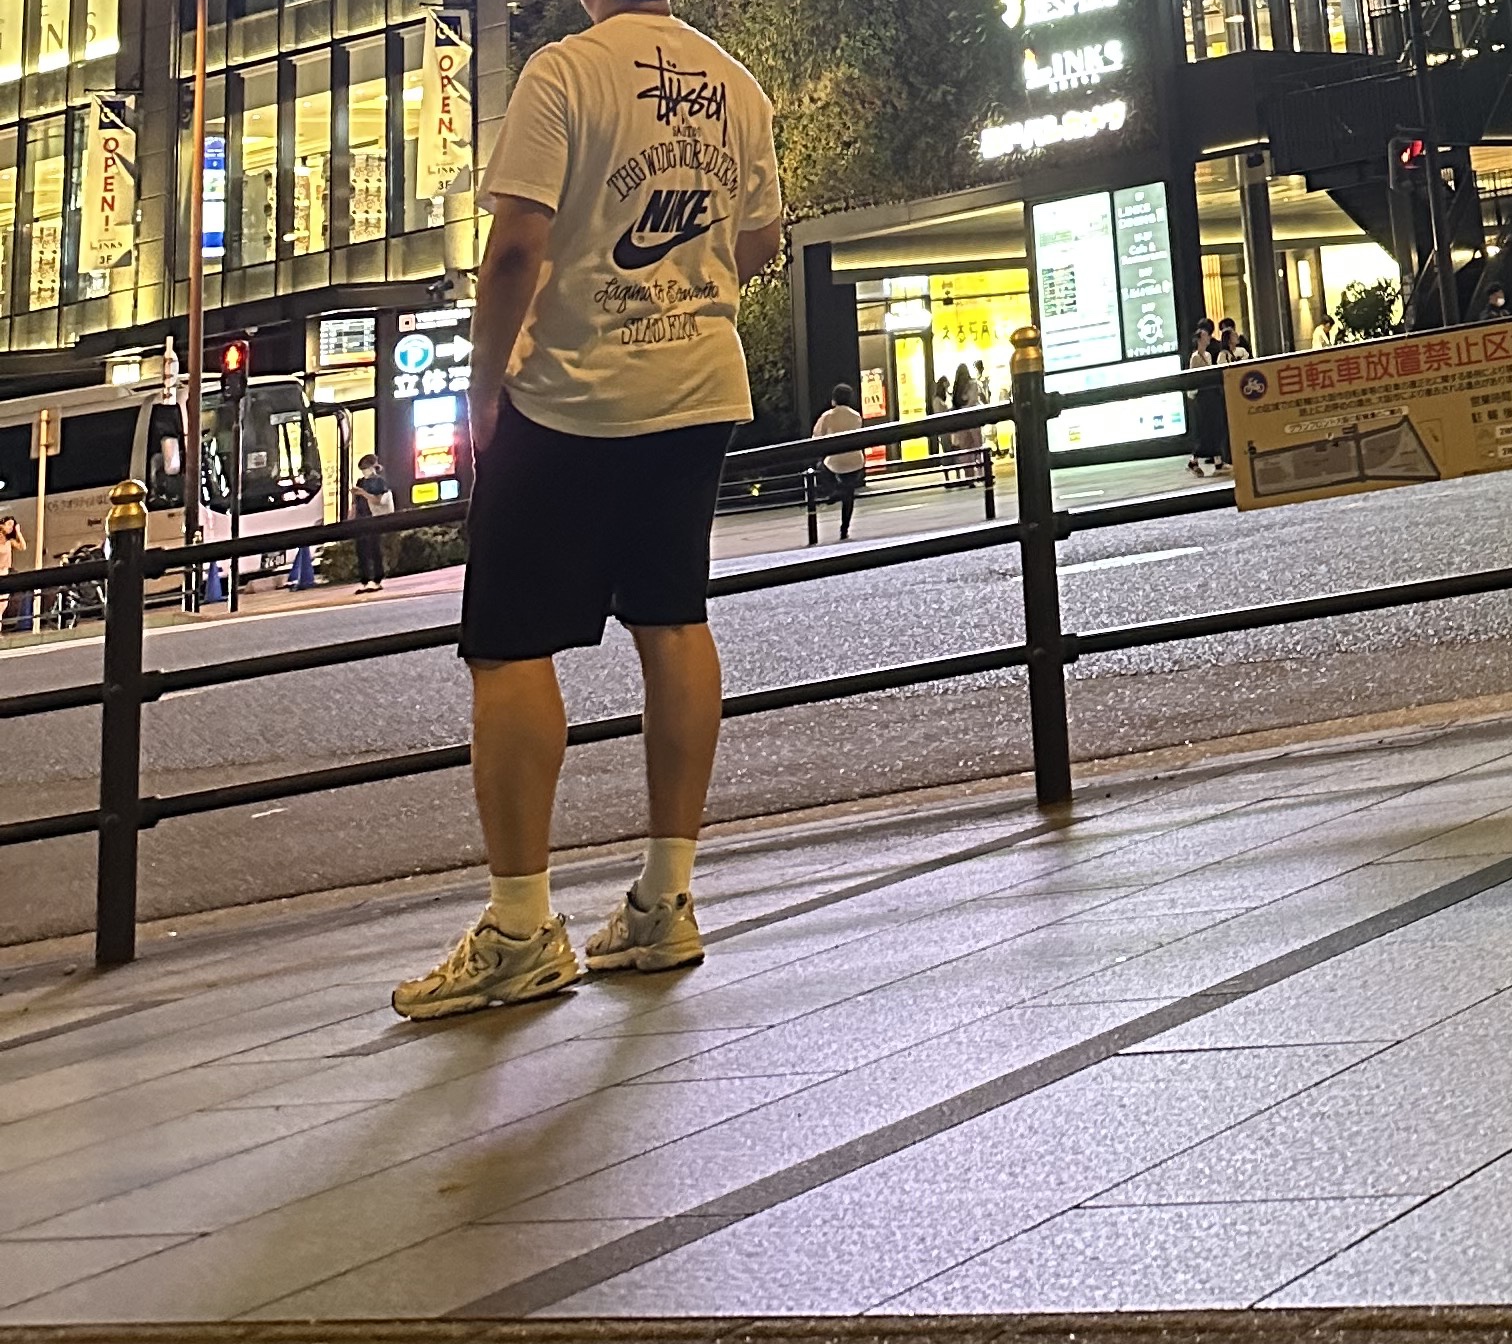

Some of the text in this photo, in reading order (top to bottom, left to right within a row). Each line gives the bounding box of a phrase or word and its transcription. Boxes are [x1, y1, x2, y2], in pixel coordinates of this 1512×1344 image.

[438, 54, 455, 156] OPEN!
[101, 136, 120, 233] OPEN!
[635, 189, 713, 233] NIKE
